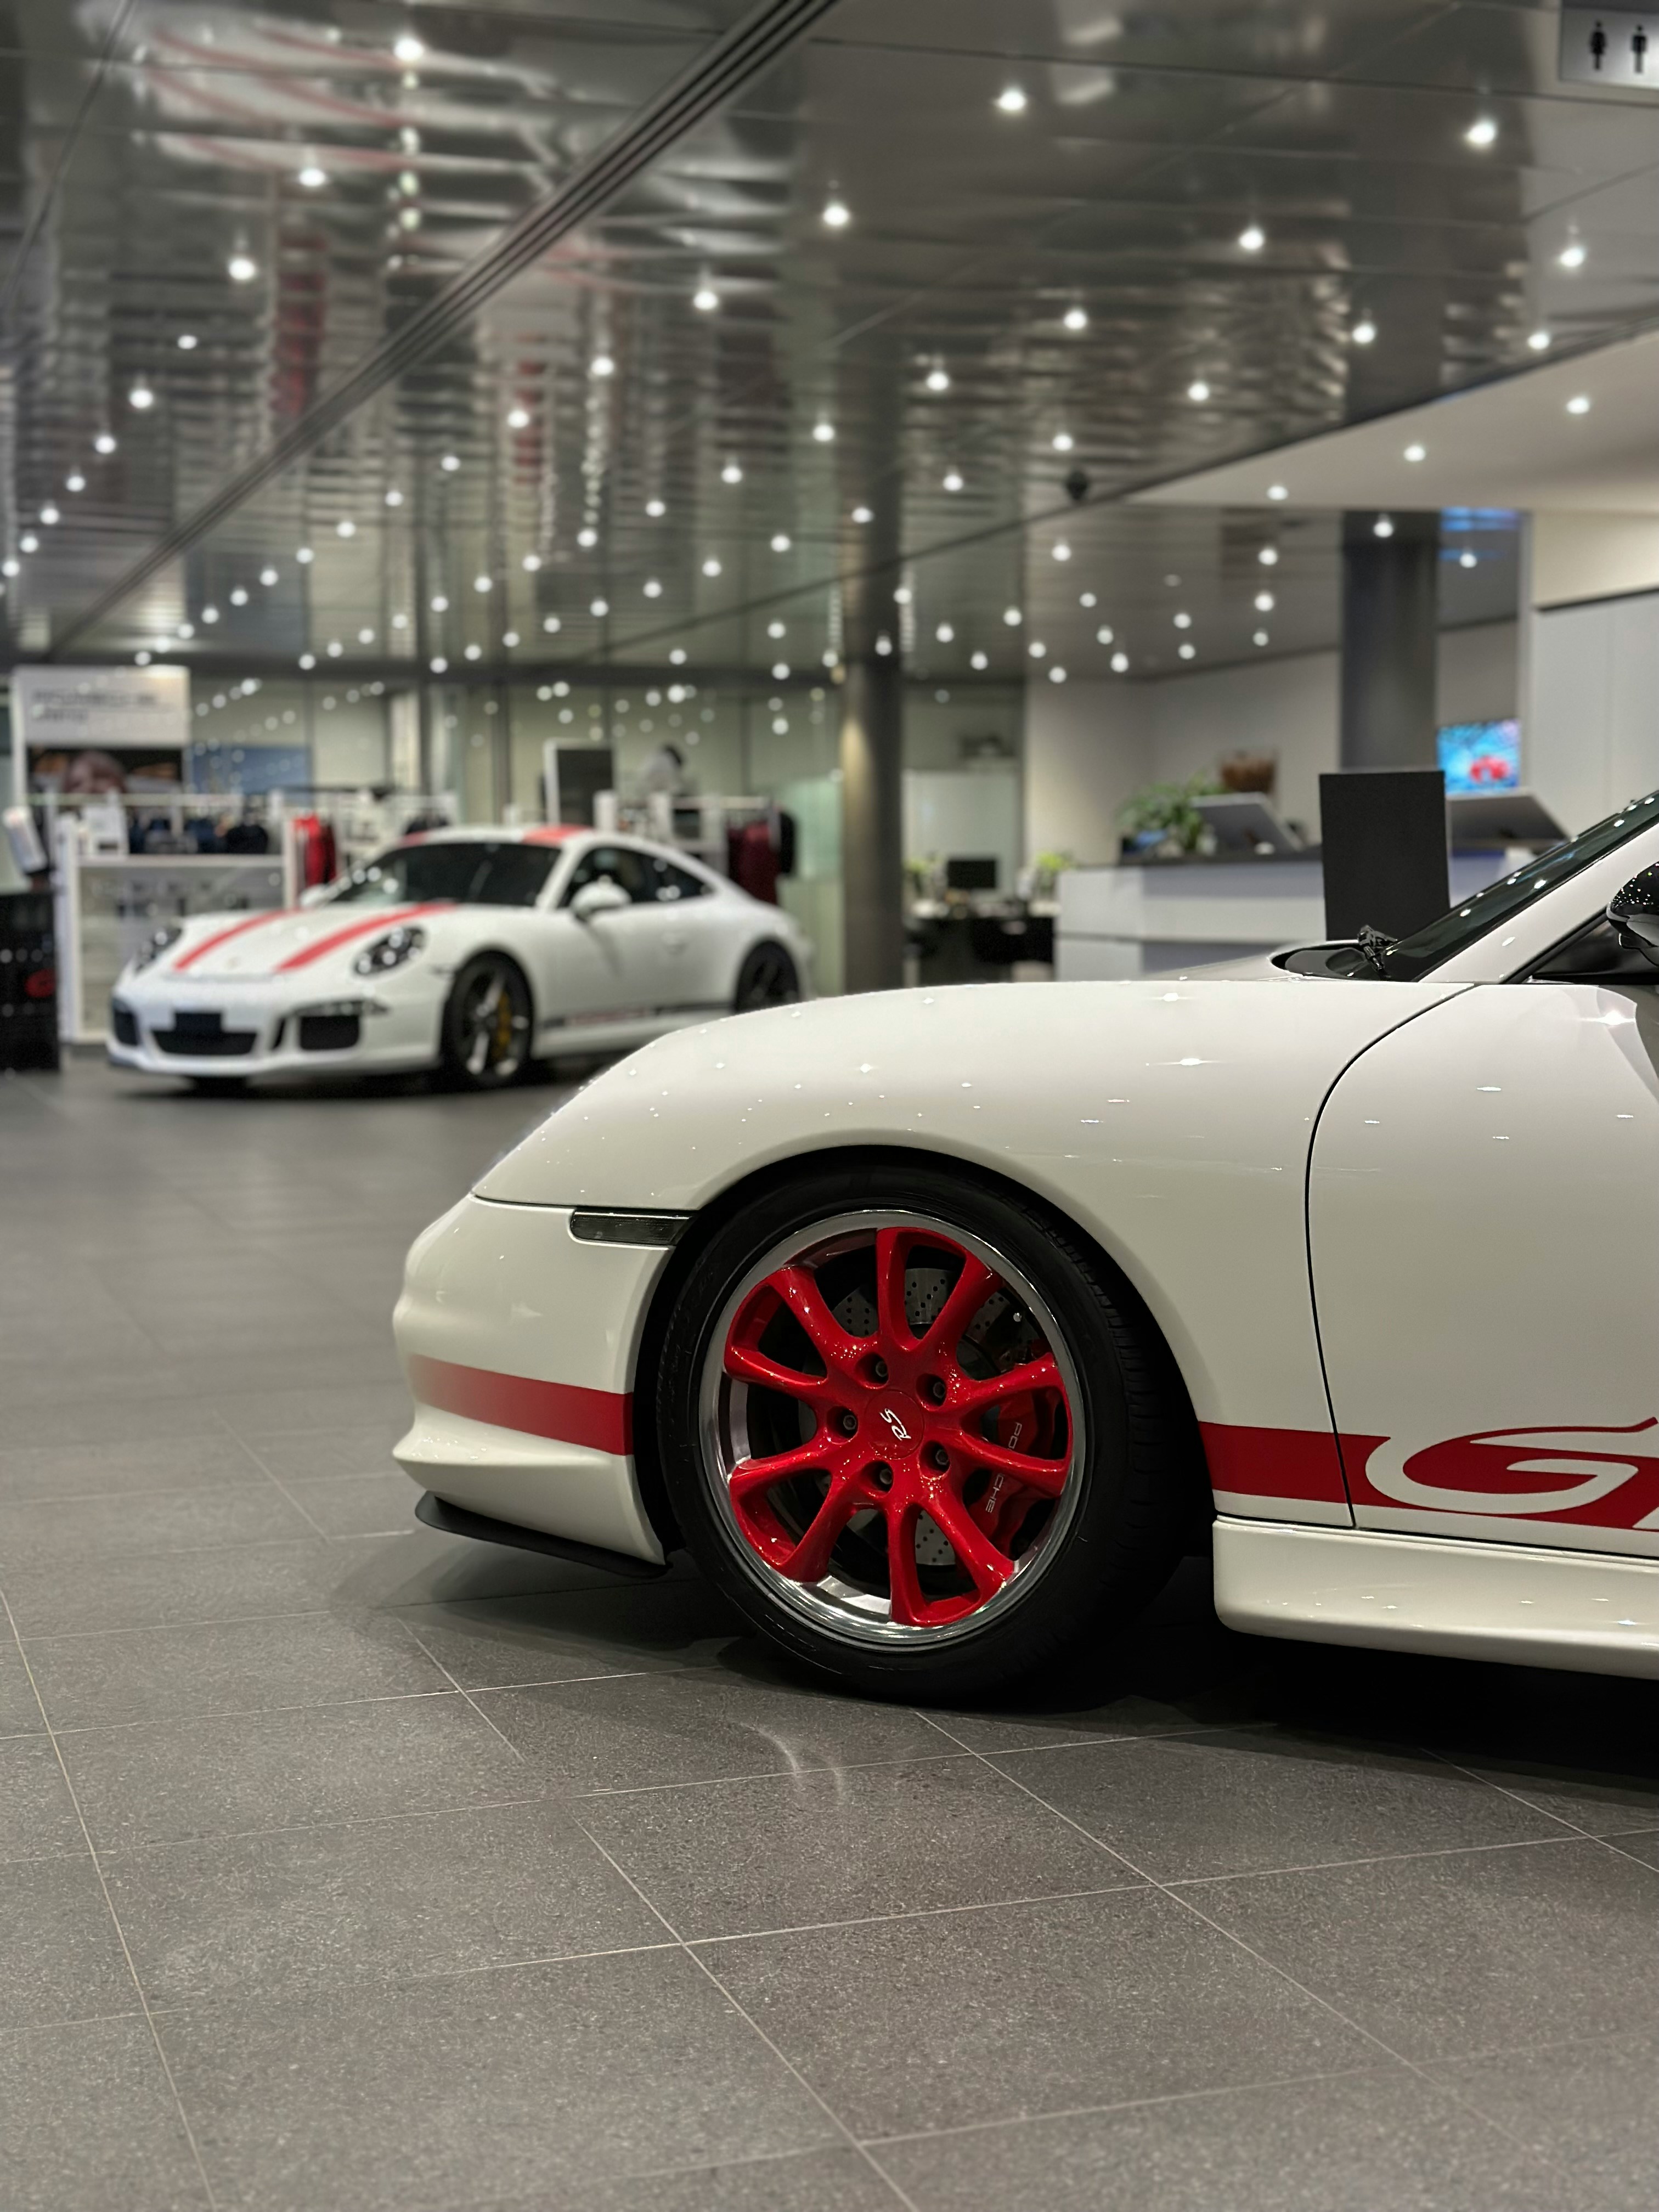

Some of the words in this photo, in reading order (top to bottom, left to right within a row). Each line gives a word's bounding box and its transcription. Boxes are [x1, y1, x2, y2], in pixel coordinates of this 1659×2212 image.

[879, 1408, 912, 1441] RS
[985, 1422, 1023, 1513] POCHE
[1365, 1417, 1659, 1528] G
